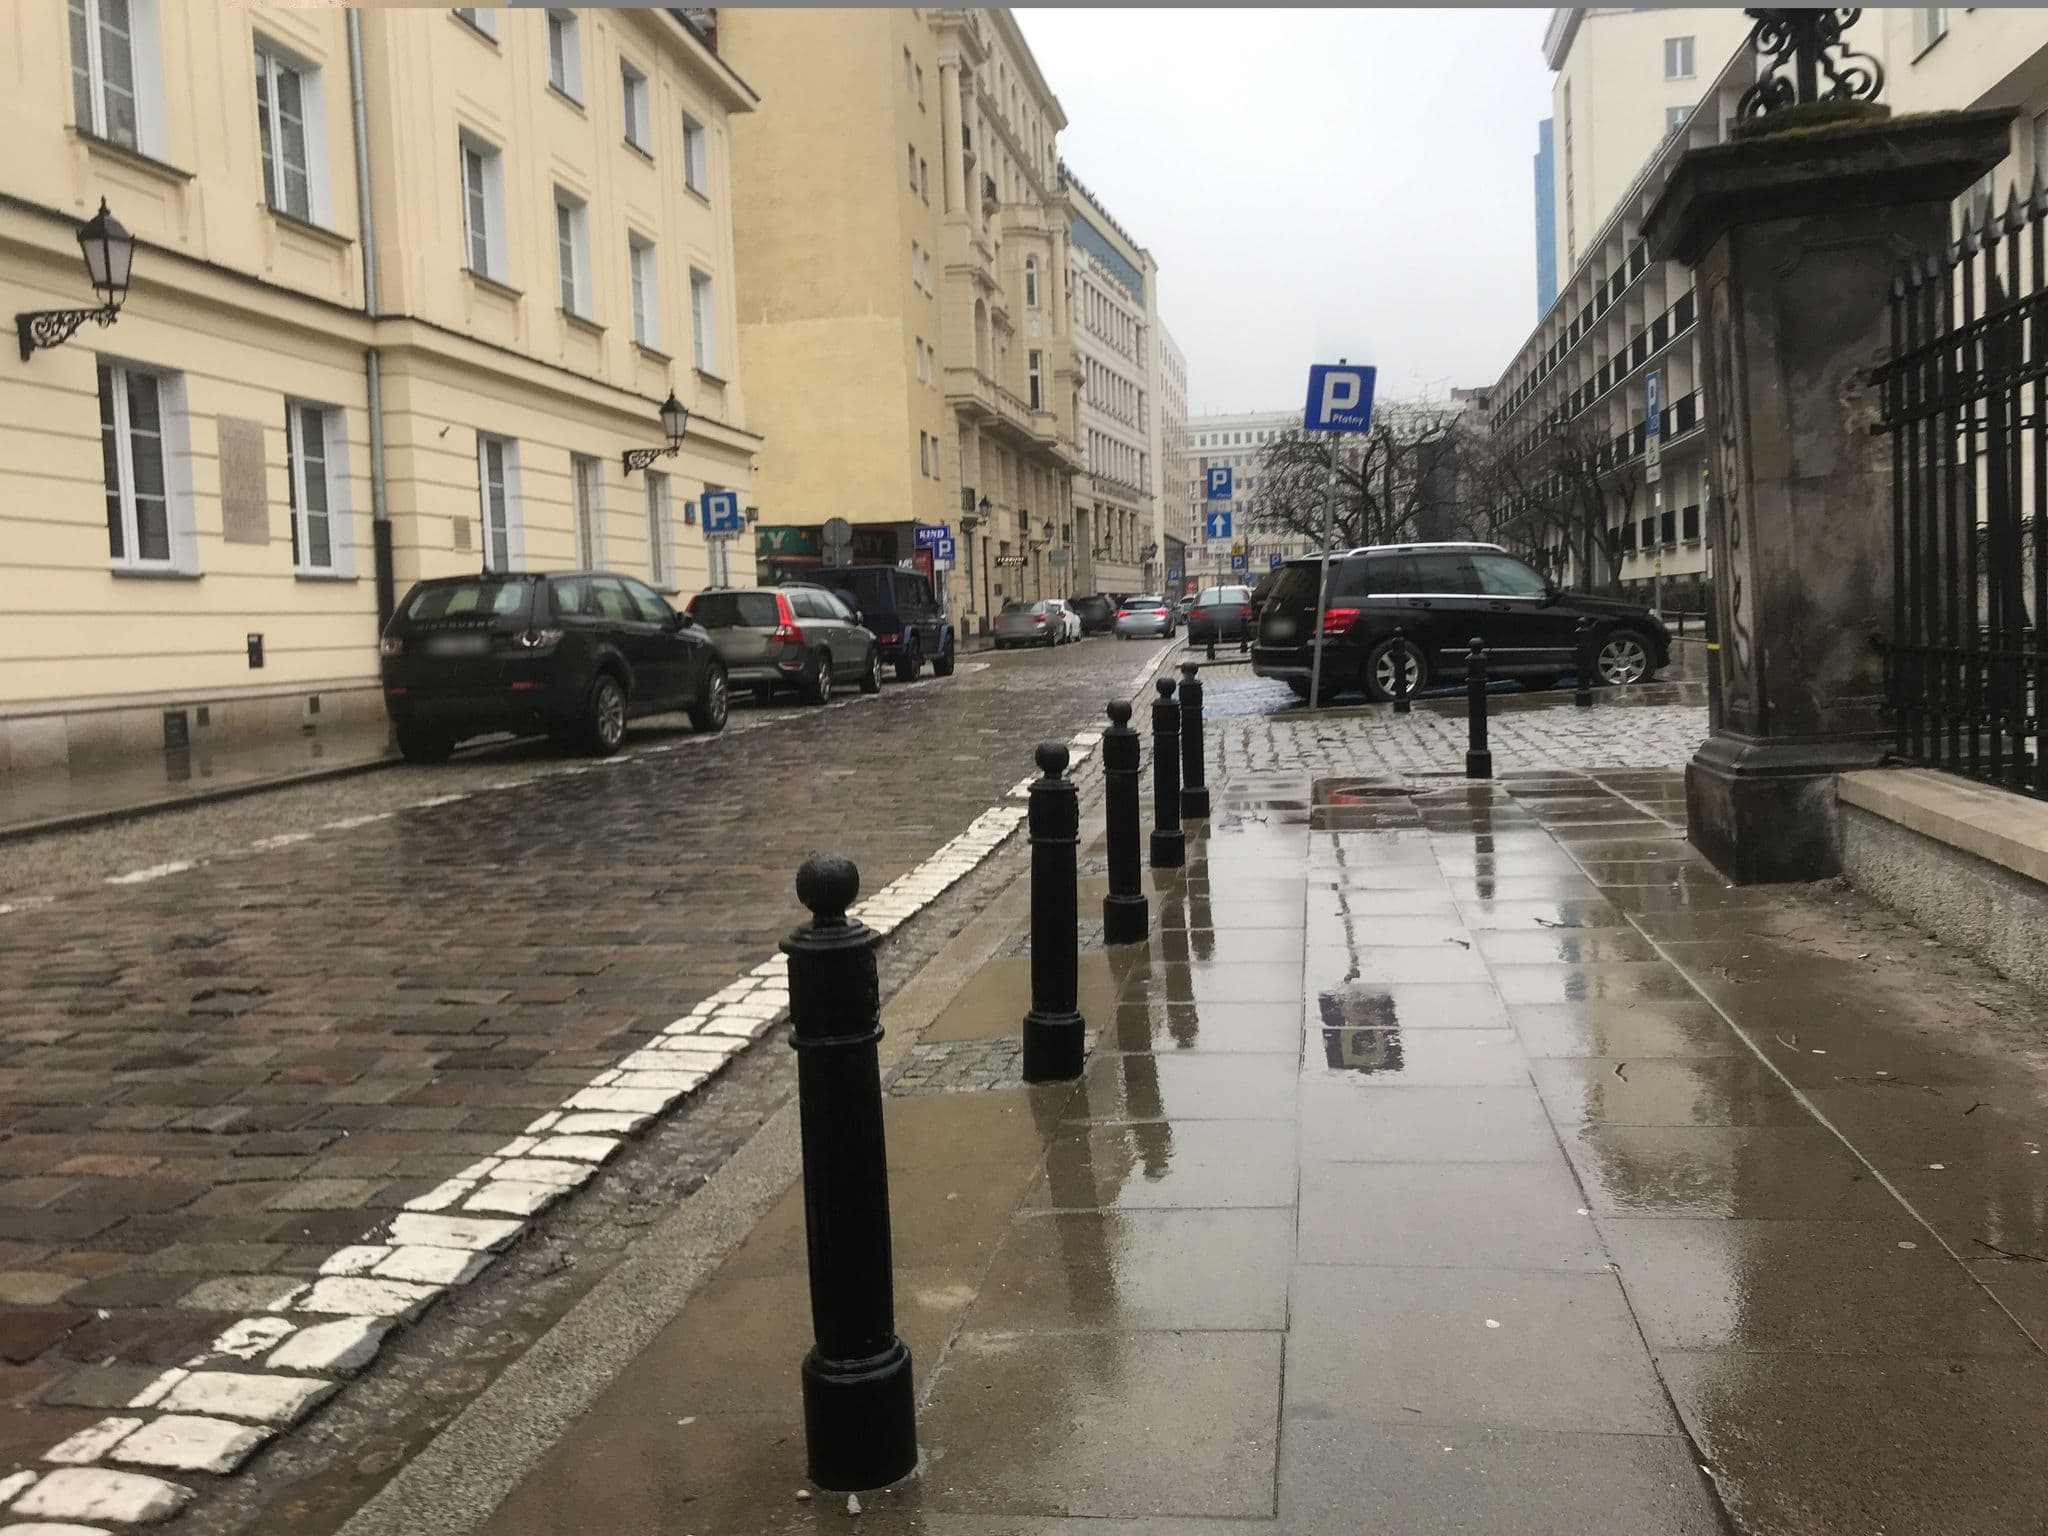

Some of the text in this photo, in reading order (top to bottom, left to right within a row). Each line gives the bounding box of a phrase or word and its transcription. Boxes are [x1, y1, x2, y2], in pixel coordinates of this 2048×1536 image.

[1320, 372, 1361, 423] P
[1647, 377, 1657, 418] P
[1212, 469, 1227, 491] P
[709, 496, 730, 528] P
[939, 540, 951, 558] P
